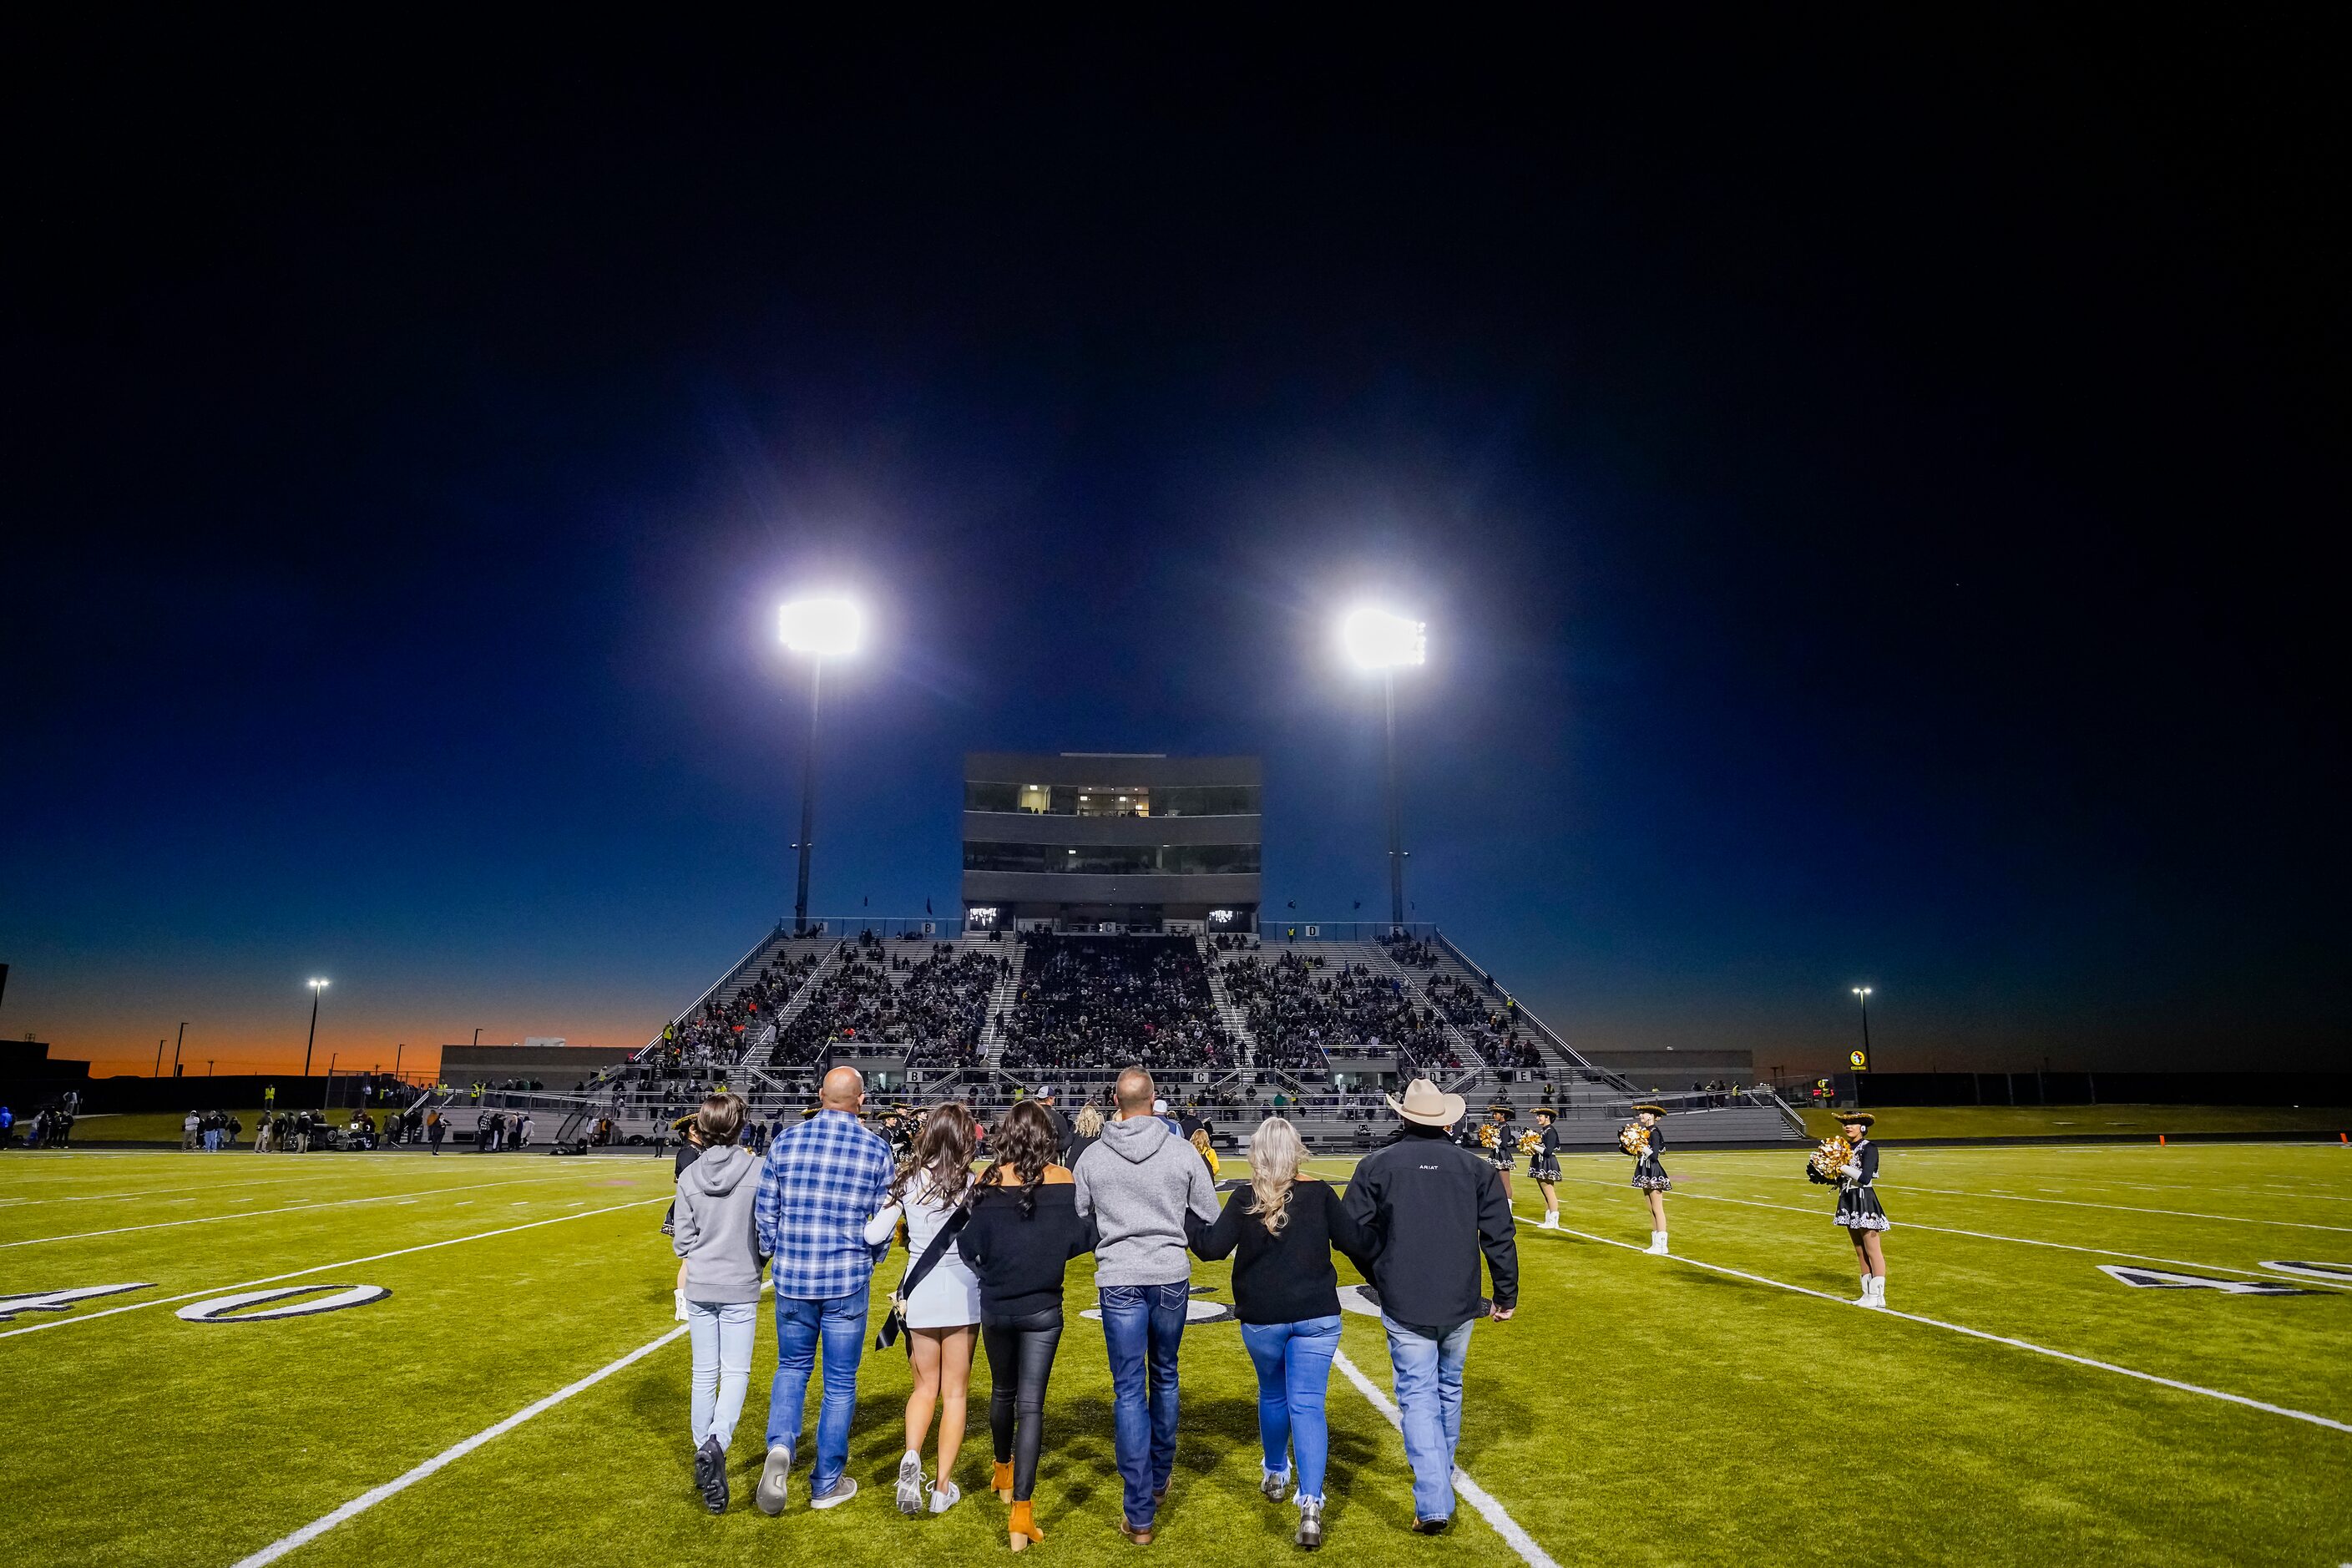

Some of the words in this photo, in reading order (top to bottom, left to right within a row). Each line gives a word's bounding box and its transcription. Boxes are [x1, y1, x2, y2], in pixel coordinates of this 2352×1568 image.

[925, 923, 931, 933] B
[1105, 923, 1112, 933] C
[1309, 926, 1316, 936] D
[911, 1071, 918, 1081] B
[1197, 1073, 1204, 1082] C
[1429, 1072, 1436, 1082] D
[1520, 1071, 1526, 1081] E
